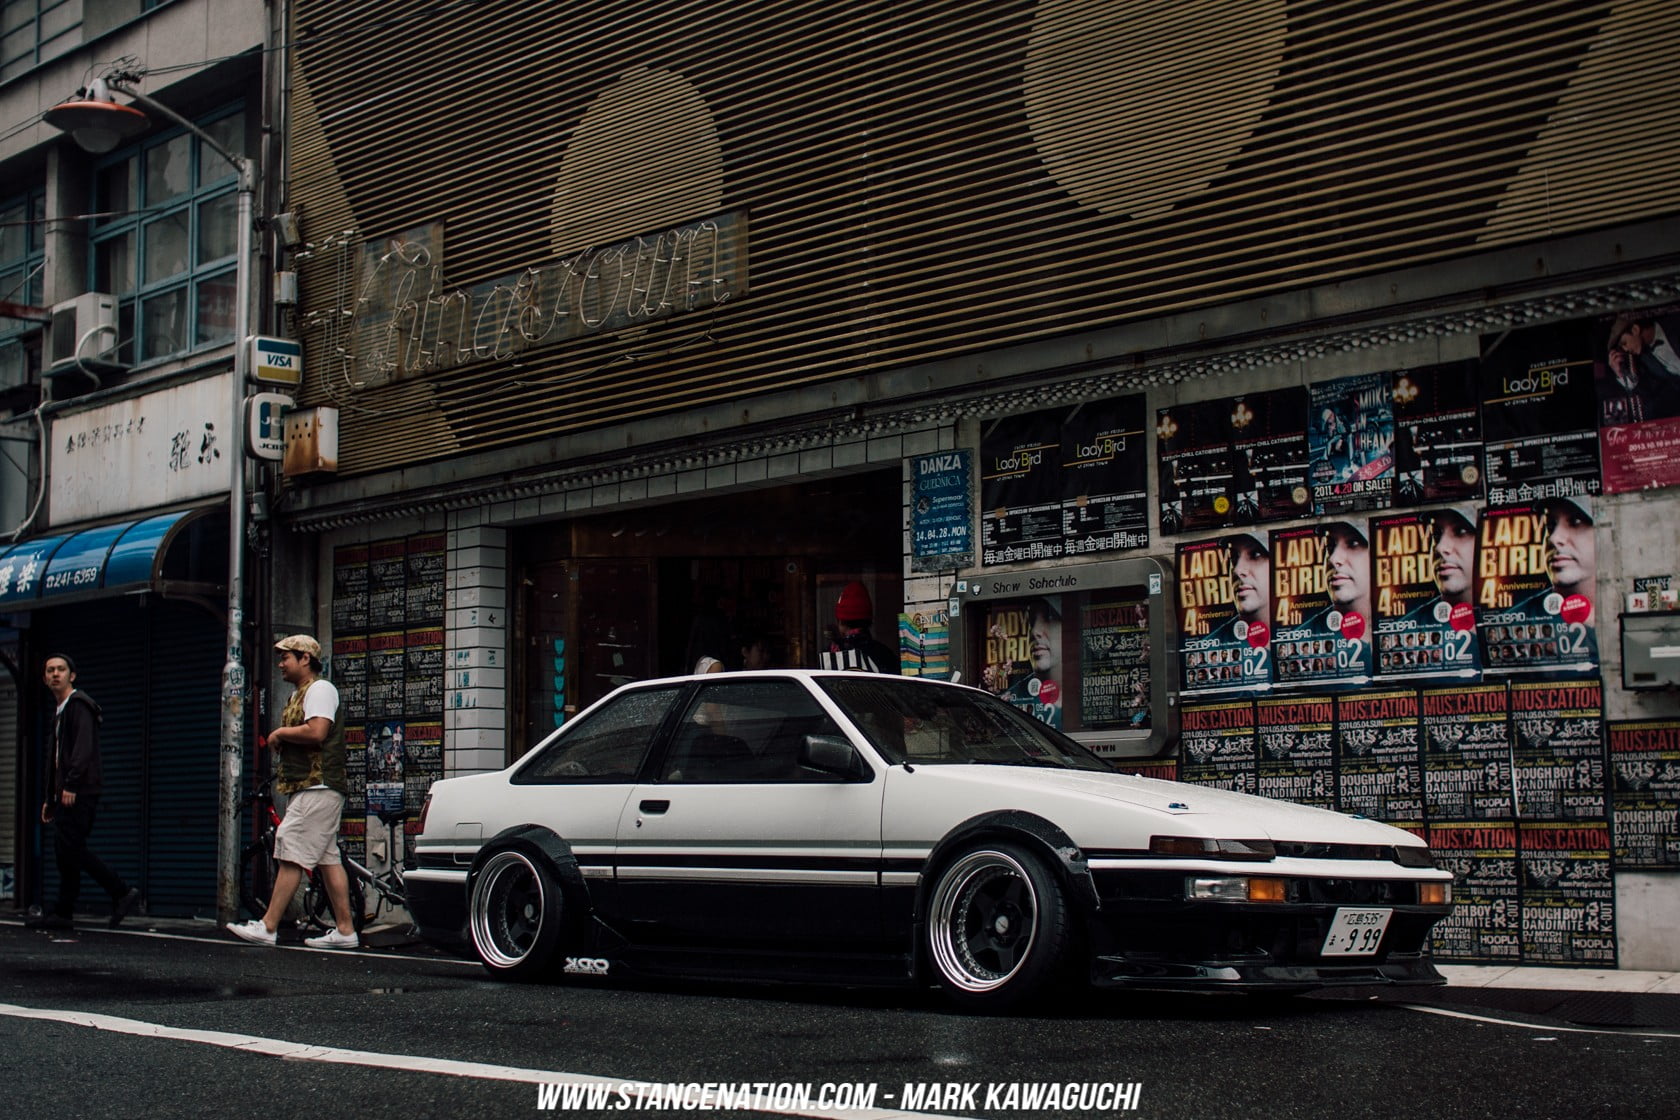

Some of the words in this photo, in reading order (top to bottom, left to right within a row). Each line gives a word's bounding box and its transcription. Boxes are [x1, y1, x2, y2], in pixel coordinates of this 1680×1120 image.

[267, 355, 292, 367] VISA
[920, 454, 962, 475] DANZA
[1353, 481, 1364, 492] ON
[1365, 478, 1392, 491] SALE!!
[1488, 477, 1600, 505] 毎週金曜日開催中
[916, 526, 967, 542] 14.04.28.MON
[1481, 514, 1546, 548] LADY
[1064, 532, 1148, 555] 毎週金曜日開催中
[1376, 522, 1431, 557] LADY
[983, 542, 1063, 565] 毎週金曜日開催中
[1275, 536, 1328, 570] LADY
[1181, 547, 1231, 580] LADY
[1480, 544, 1547, 579] BIRD
[1376, 553, 1434, 587] BIRD
[54, 567, 97, 588] 241-6359
[993, 581, 1020, 594] Show
[1029, 574, 1077, 590] Schedule
[1275, 563, 1330, 599] BIRD
[1181, 575, 1234, 610] BIRD
[1497, 580, 1547, 592] Anniversary
[1392, 590, 1436, 601] Anniversary
[1289, 599, 1329, 610] Anniversary
[1197, 609, 1234, 620] Anniversary
[1556, 623, 1568, 633] 05
[1444, 631, 1456, 640] 05
[1336, 639, 1347, 649] 05
[1243, 647, 1254, 657] 05
[1090, 744, 1116, 754] TOWN
[1340, 773, 1375, 786] DOUGH
[1376, 772, 1396, 785] BOY
[1410, 765, 1420, 793] K-OUT
[1425, 768, 1461, 782] DOUGH
[1462, 768, 1484, 781] BOY
[1500, 762, 1511, 791] K-OUT
[1515, 767, 1553, 781] DOUGH
[1554, 766, 1576, 780] BOY
[1591, 759, 1605, 791] K-OUT
[1218, 780, 1234, 791] BOY
[1259, 777, 1292, 789] DOUGH
[1293, 776, 1313, 788] BOY
[1324, 769, 1335, 797] K-OUT
[1425, 780, 1485, 793] DANDIMITE
[1515, 779, 1576, 792] DANDIMITE
[1340, 784, 1396, 797] DANDIMITE
[1386, 800, 1422, 810] HOOPLA
[1474, 797, 1511, 808] HOOPLA
[1563, 796, 1605, 808] HOOPLA
[1613, 810, 1654, 823] DOUGH
[1655, 810, 1679, 823] BOY
[1613, 822, 1679, 835] DANDIMITE
[1471, 905, 1492, 917] BOY
[1507, 899, 1519, 929] K-OUT
[1522, 907, 1562, 921] DOUGH
[1563, 907, 1585, 920] BOY
[1600, 901, 1613, 933] K-OUT
[1522, 919, 1584, 932] DANDIMITE
[1480, 935, 1520, 945] HOOPLA
[1572, 938, 1615, 949] HOOPLA
